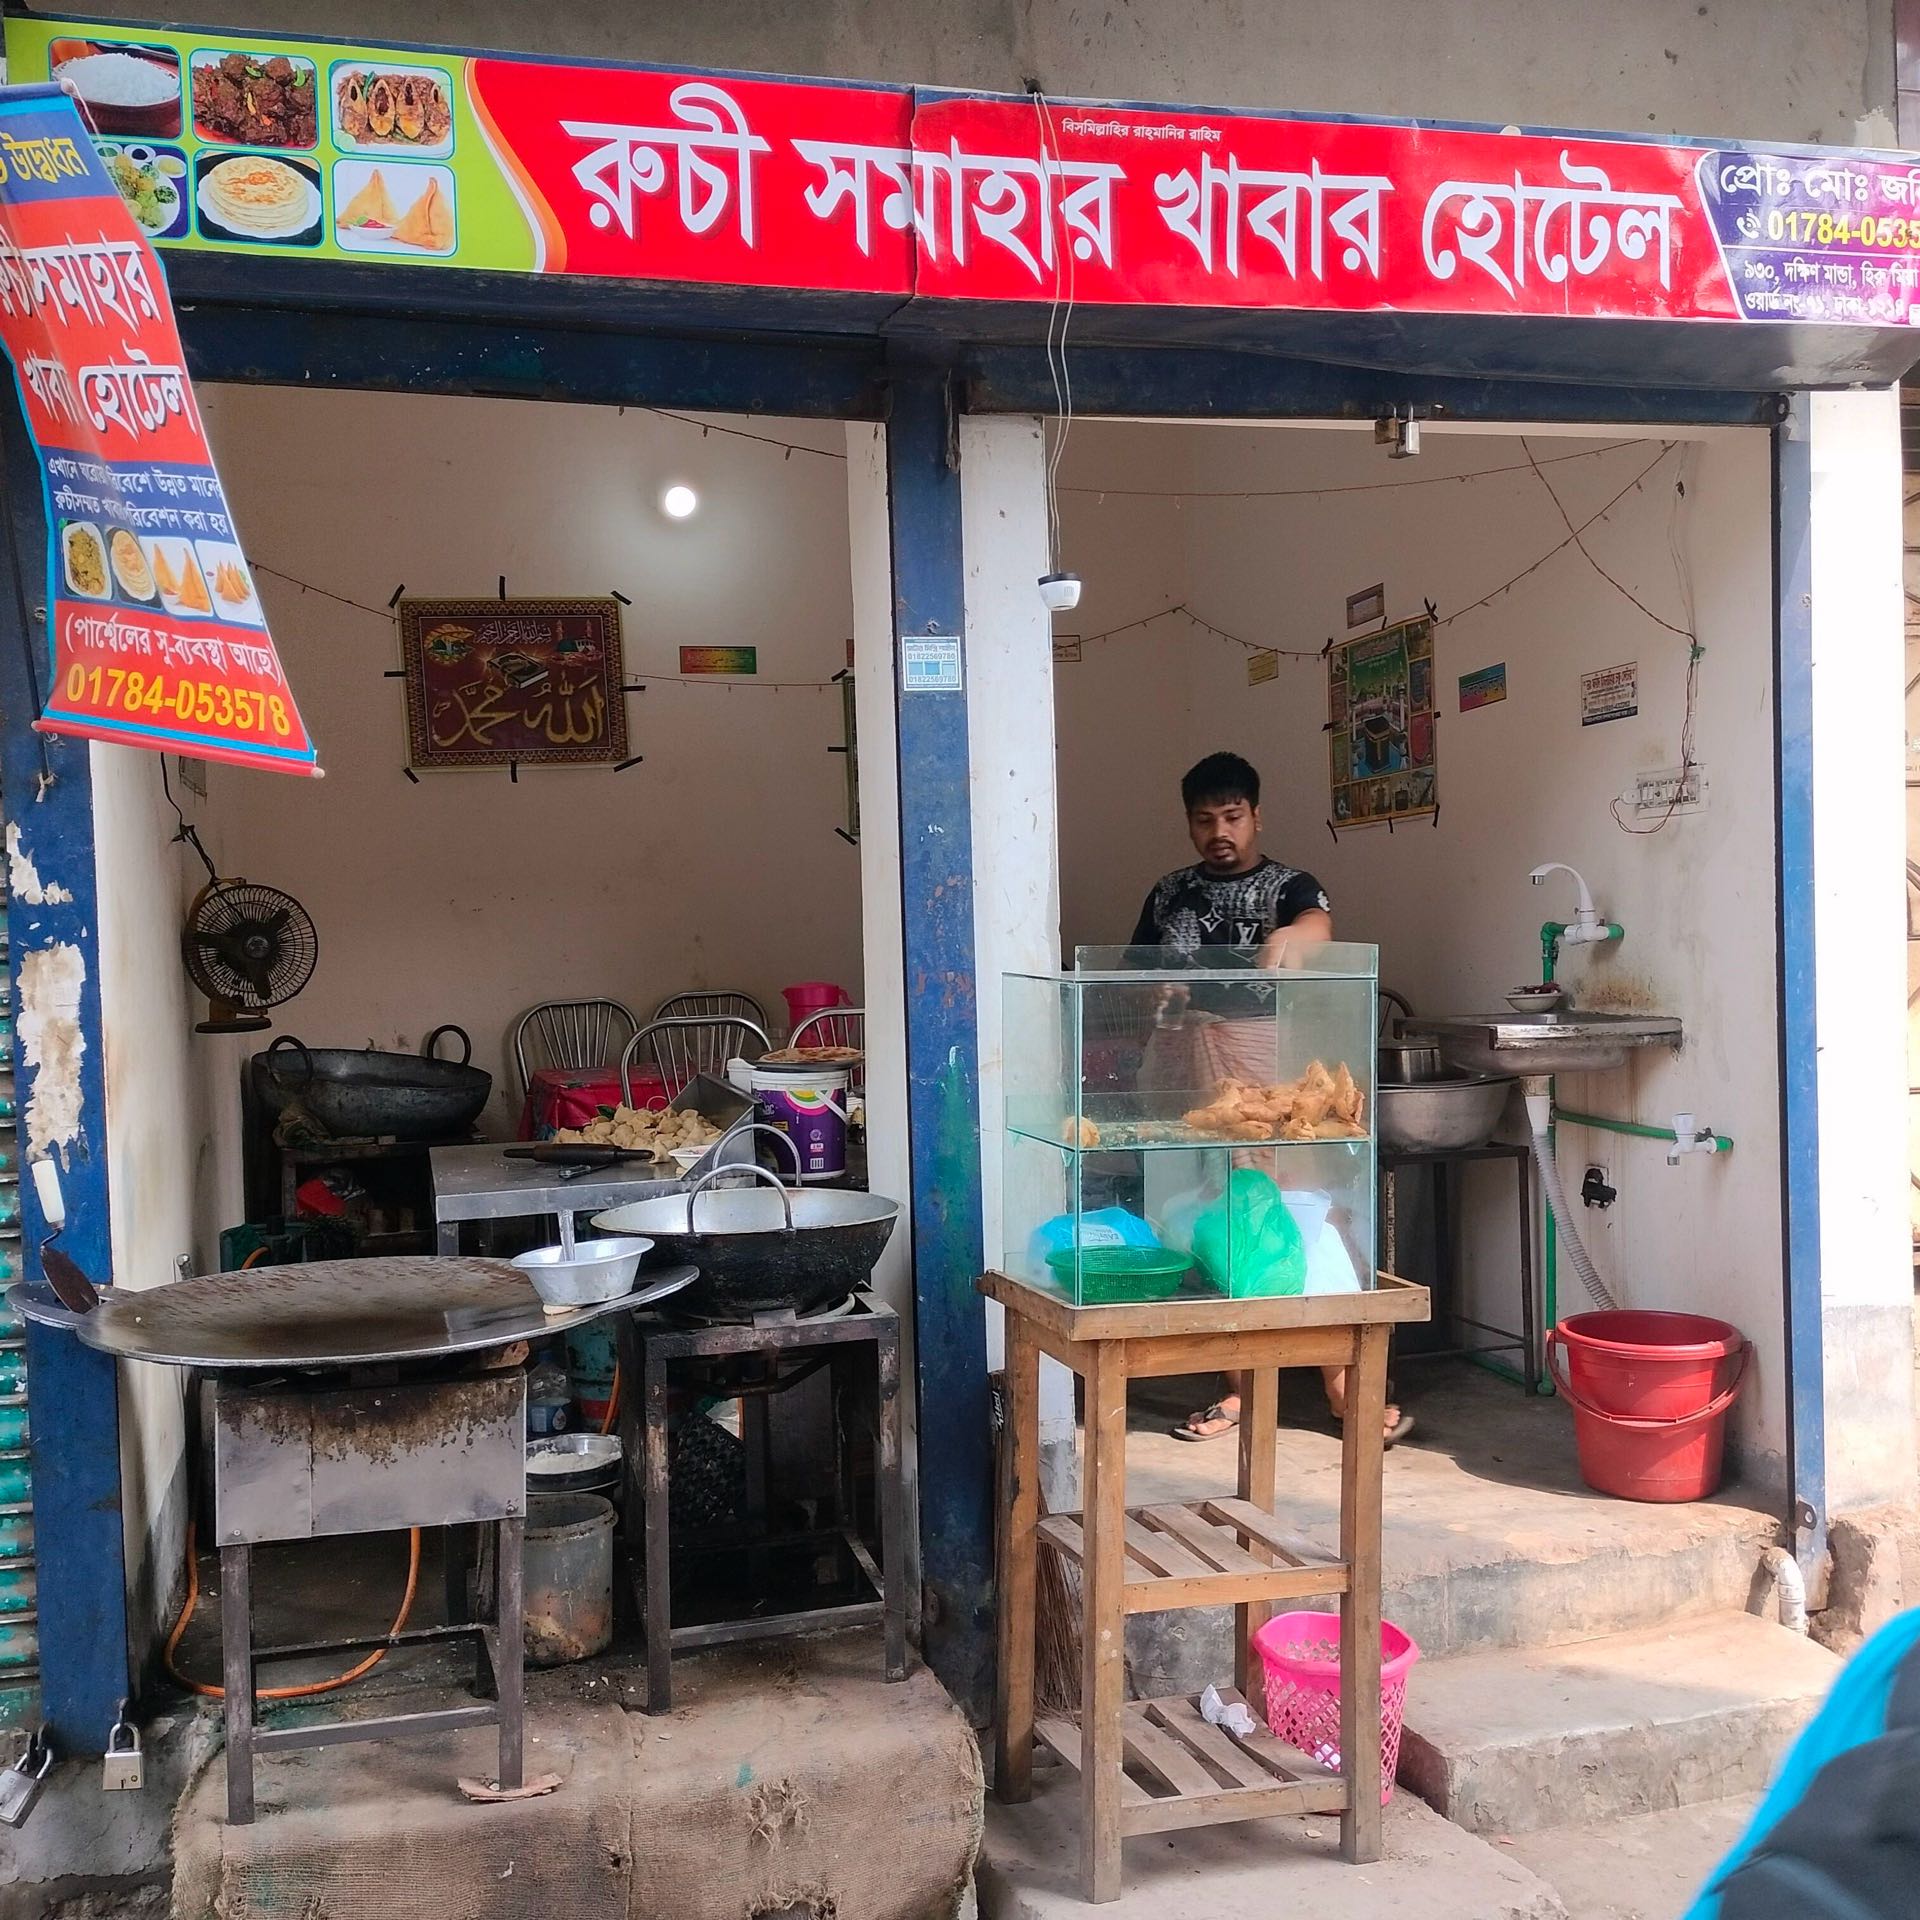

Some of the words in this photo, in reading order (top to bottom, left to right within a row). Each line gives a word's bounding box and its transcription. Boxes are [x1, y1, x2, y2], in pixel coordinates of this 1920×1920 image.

[1188, 126, 1222, 142] রাহিম
[558, 82, 773, 250] রুচী
[790, 135, 1128, 285] সমাহার
[1152, 150, 1395, 283] খাবার
[1421, 149, 1685, 300] হোটেল
[77, 338, 198, 444] হোটেল
[66, 663, 291, 736] 01784-053578
